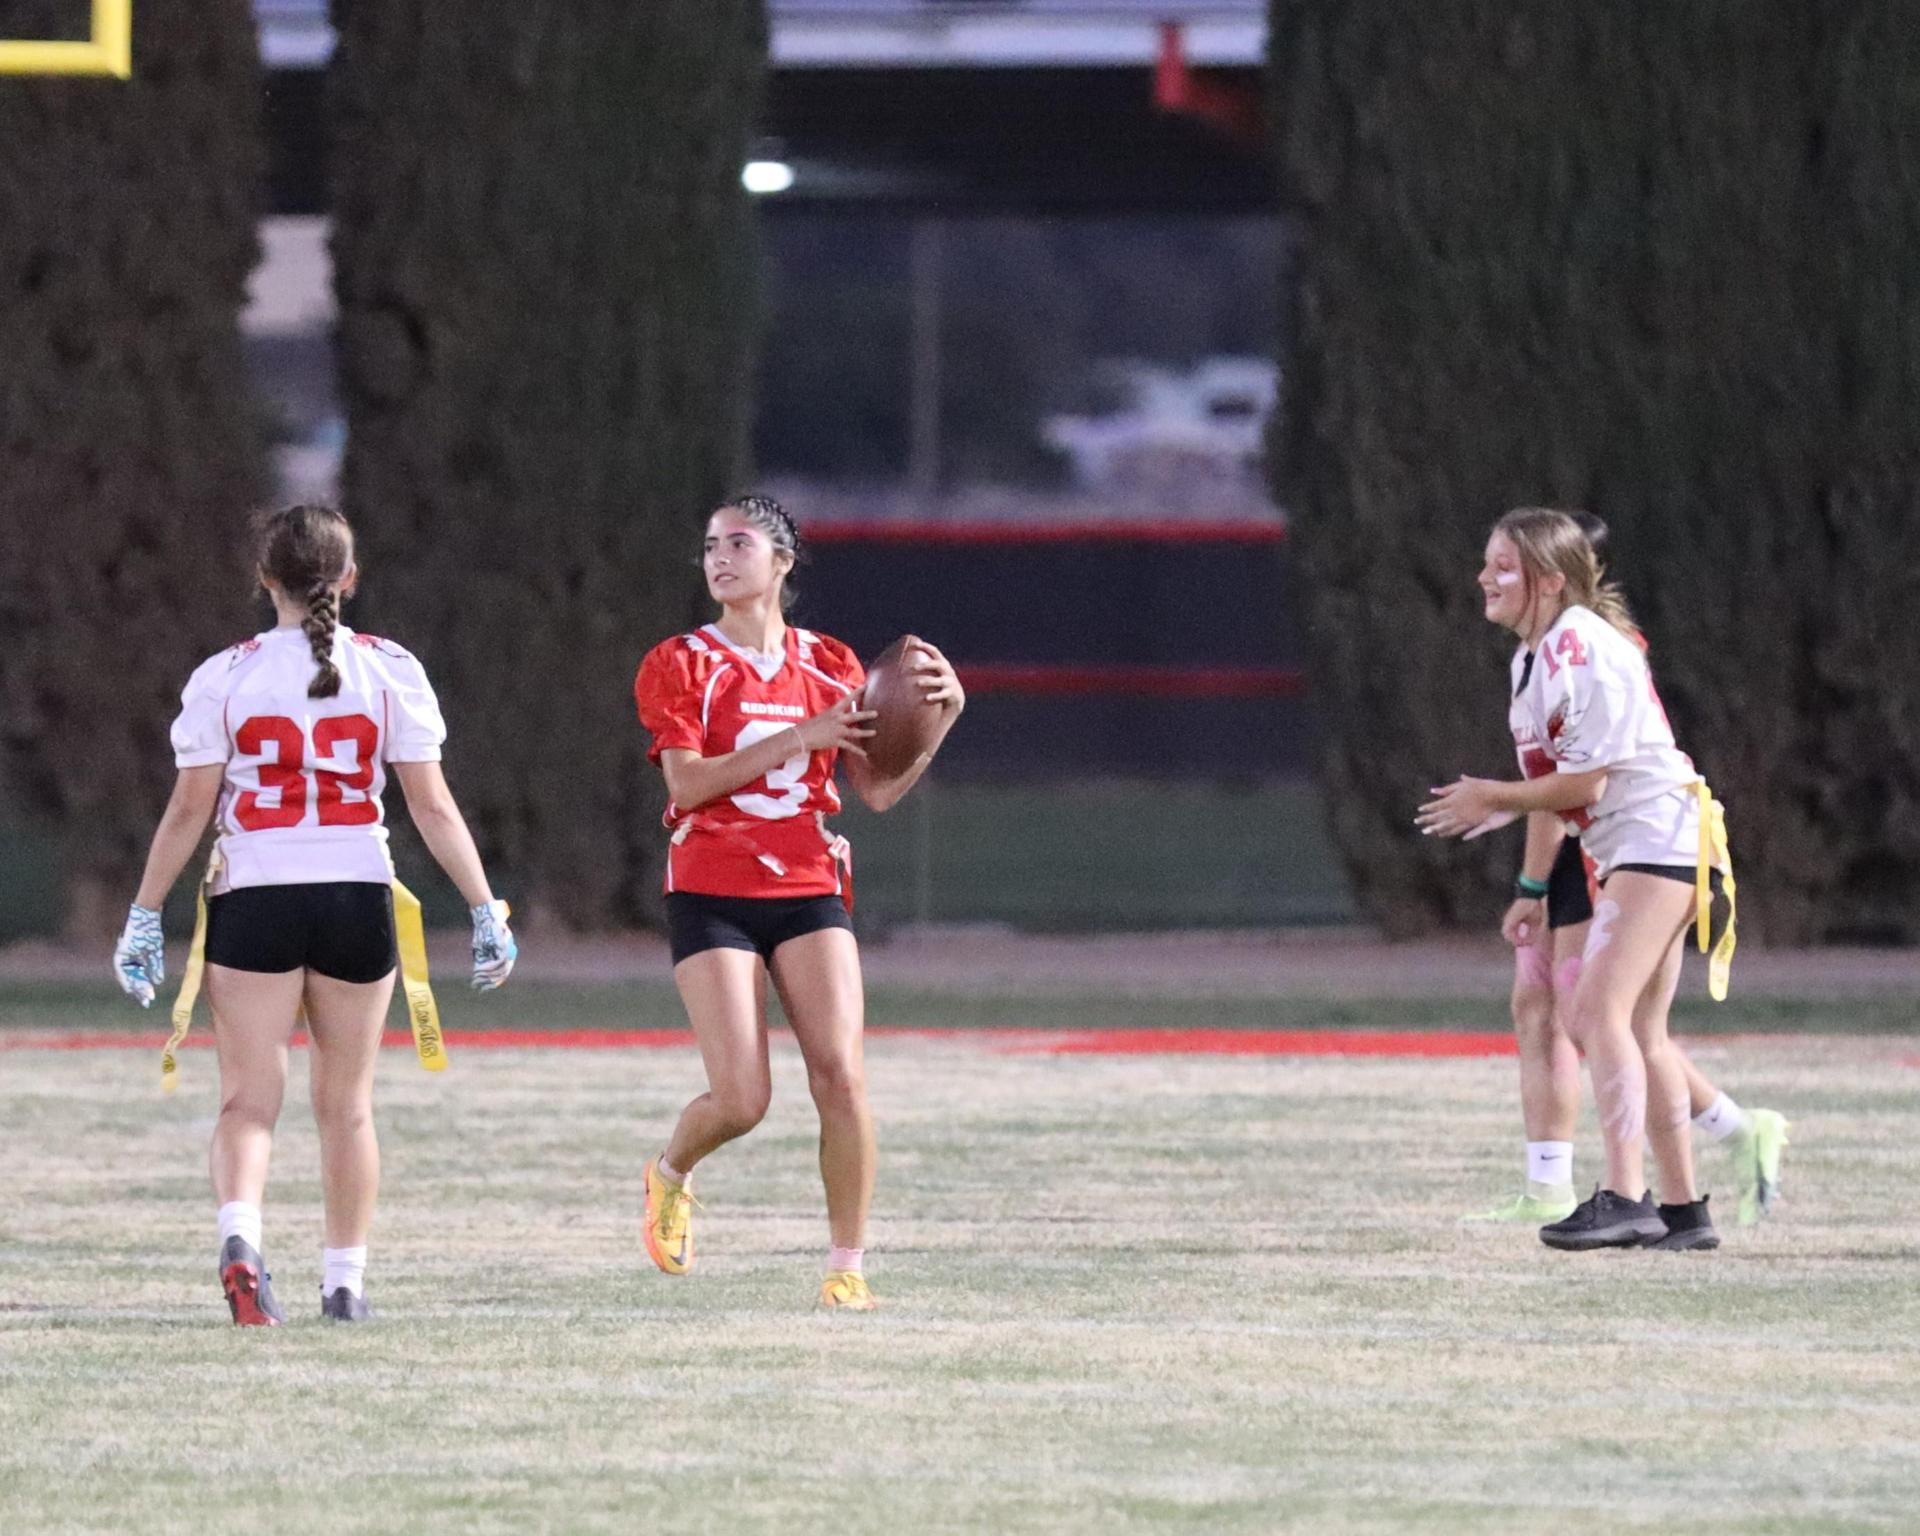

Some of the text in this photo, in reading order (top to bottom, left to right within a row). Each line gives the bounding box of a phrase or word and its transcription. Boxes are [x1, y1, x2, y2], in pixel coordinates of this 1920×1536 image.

[1543, 628, 1587, 681] 14
[234, 714, 379, 832] 32
[731, 720, 811, 820] 3
